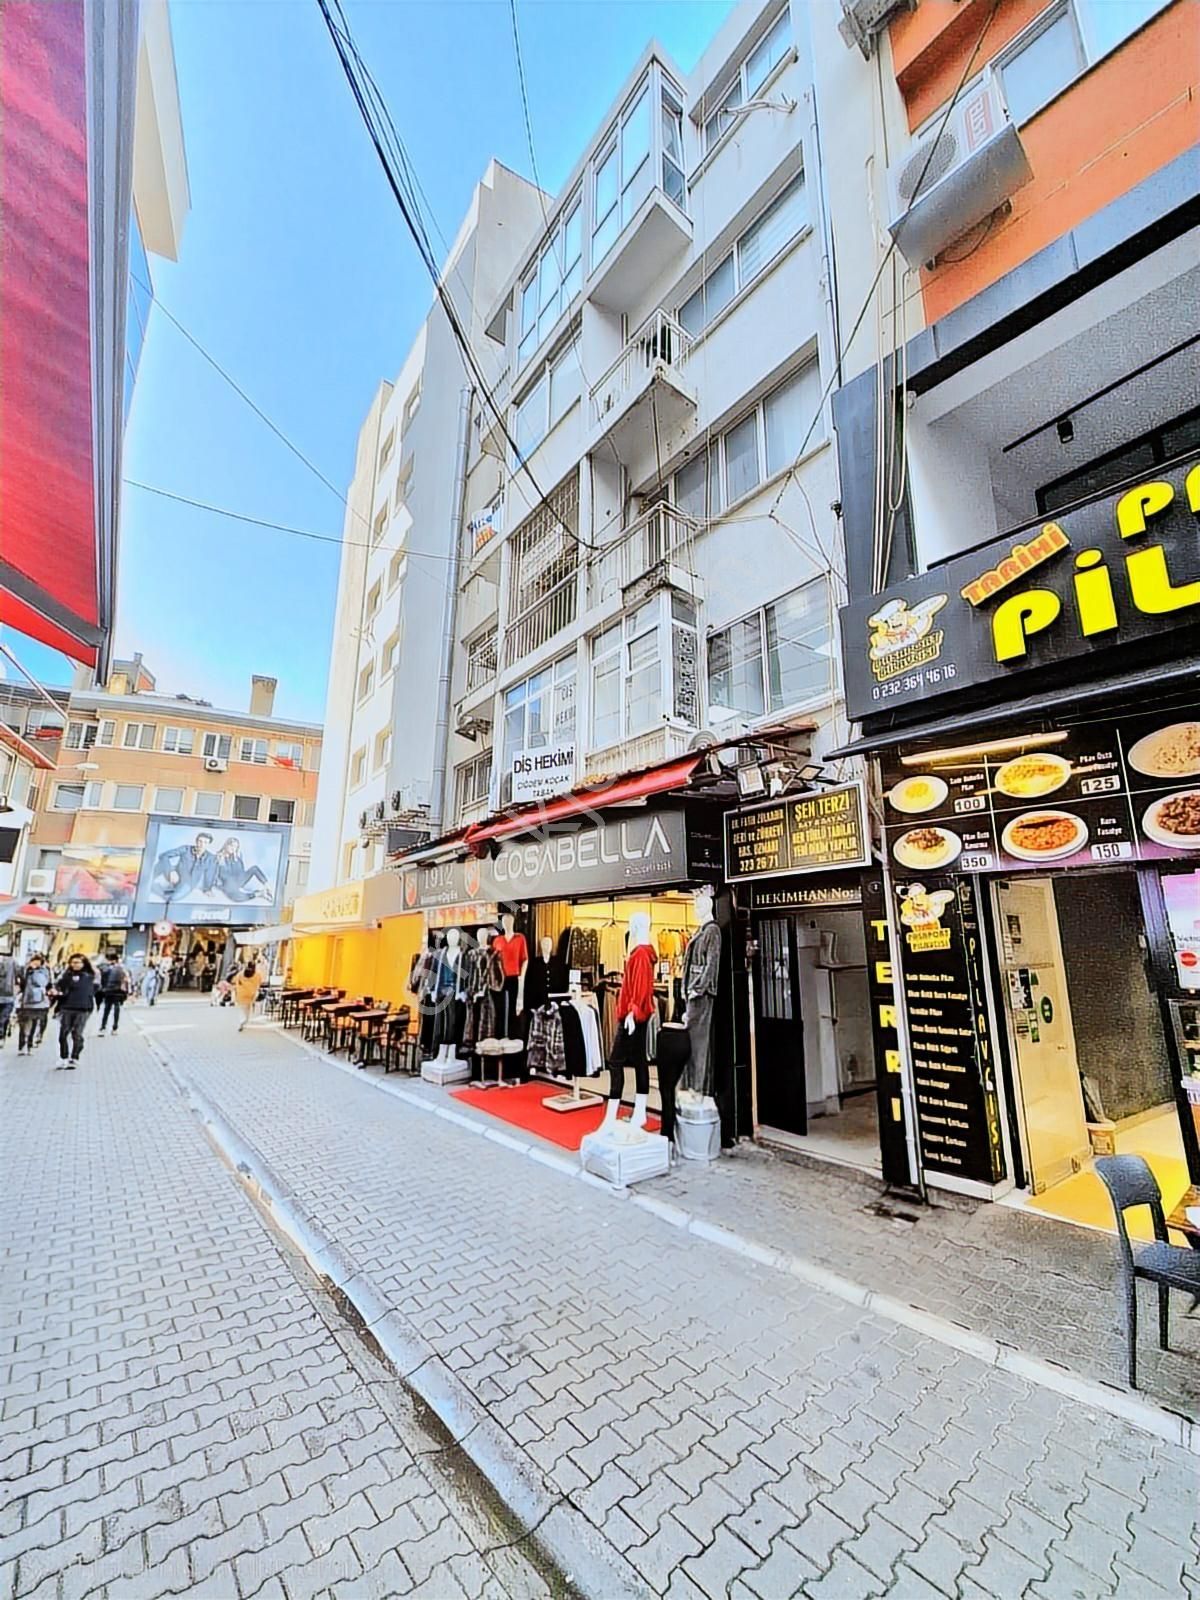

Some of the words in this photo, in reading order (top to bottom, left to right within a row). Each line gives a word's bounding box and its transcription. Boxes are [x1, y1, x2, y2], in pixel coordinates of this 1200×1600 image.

[872, 687, 880, 700] 0
[881, 680, 901, 698] 232
[904, 673, 923, 691] 364
[926, 668, 940, 684] 46
[944, 663, 956, 679] 16
[514, 754, 532, 775] DİŞ
[535, 746, 574, 771] HEKİMİ
[1082, 777, 1114, 791] 125
[956, 799, 980, 810] 100
[493, 816, 671, 882] COSABELLA
[1096, 843, 1120, 858] 150
[962, 856, 987, 868] 350
[756, 888, 827, 905] HEKİMHAN
